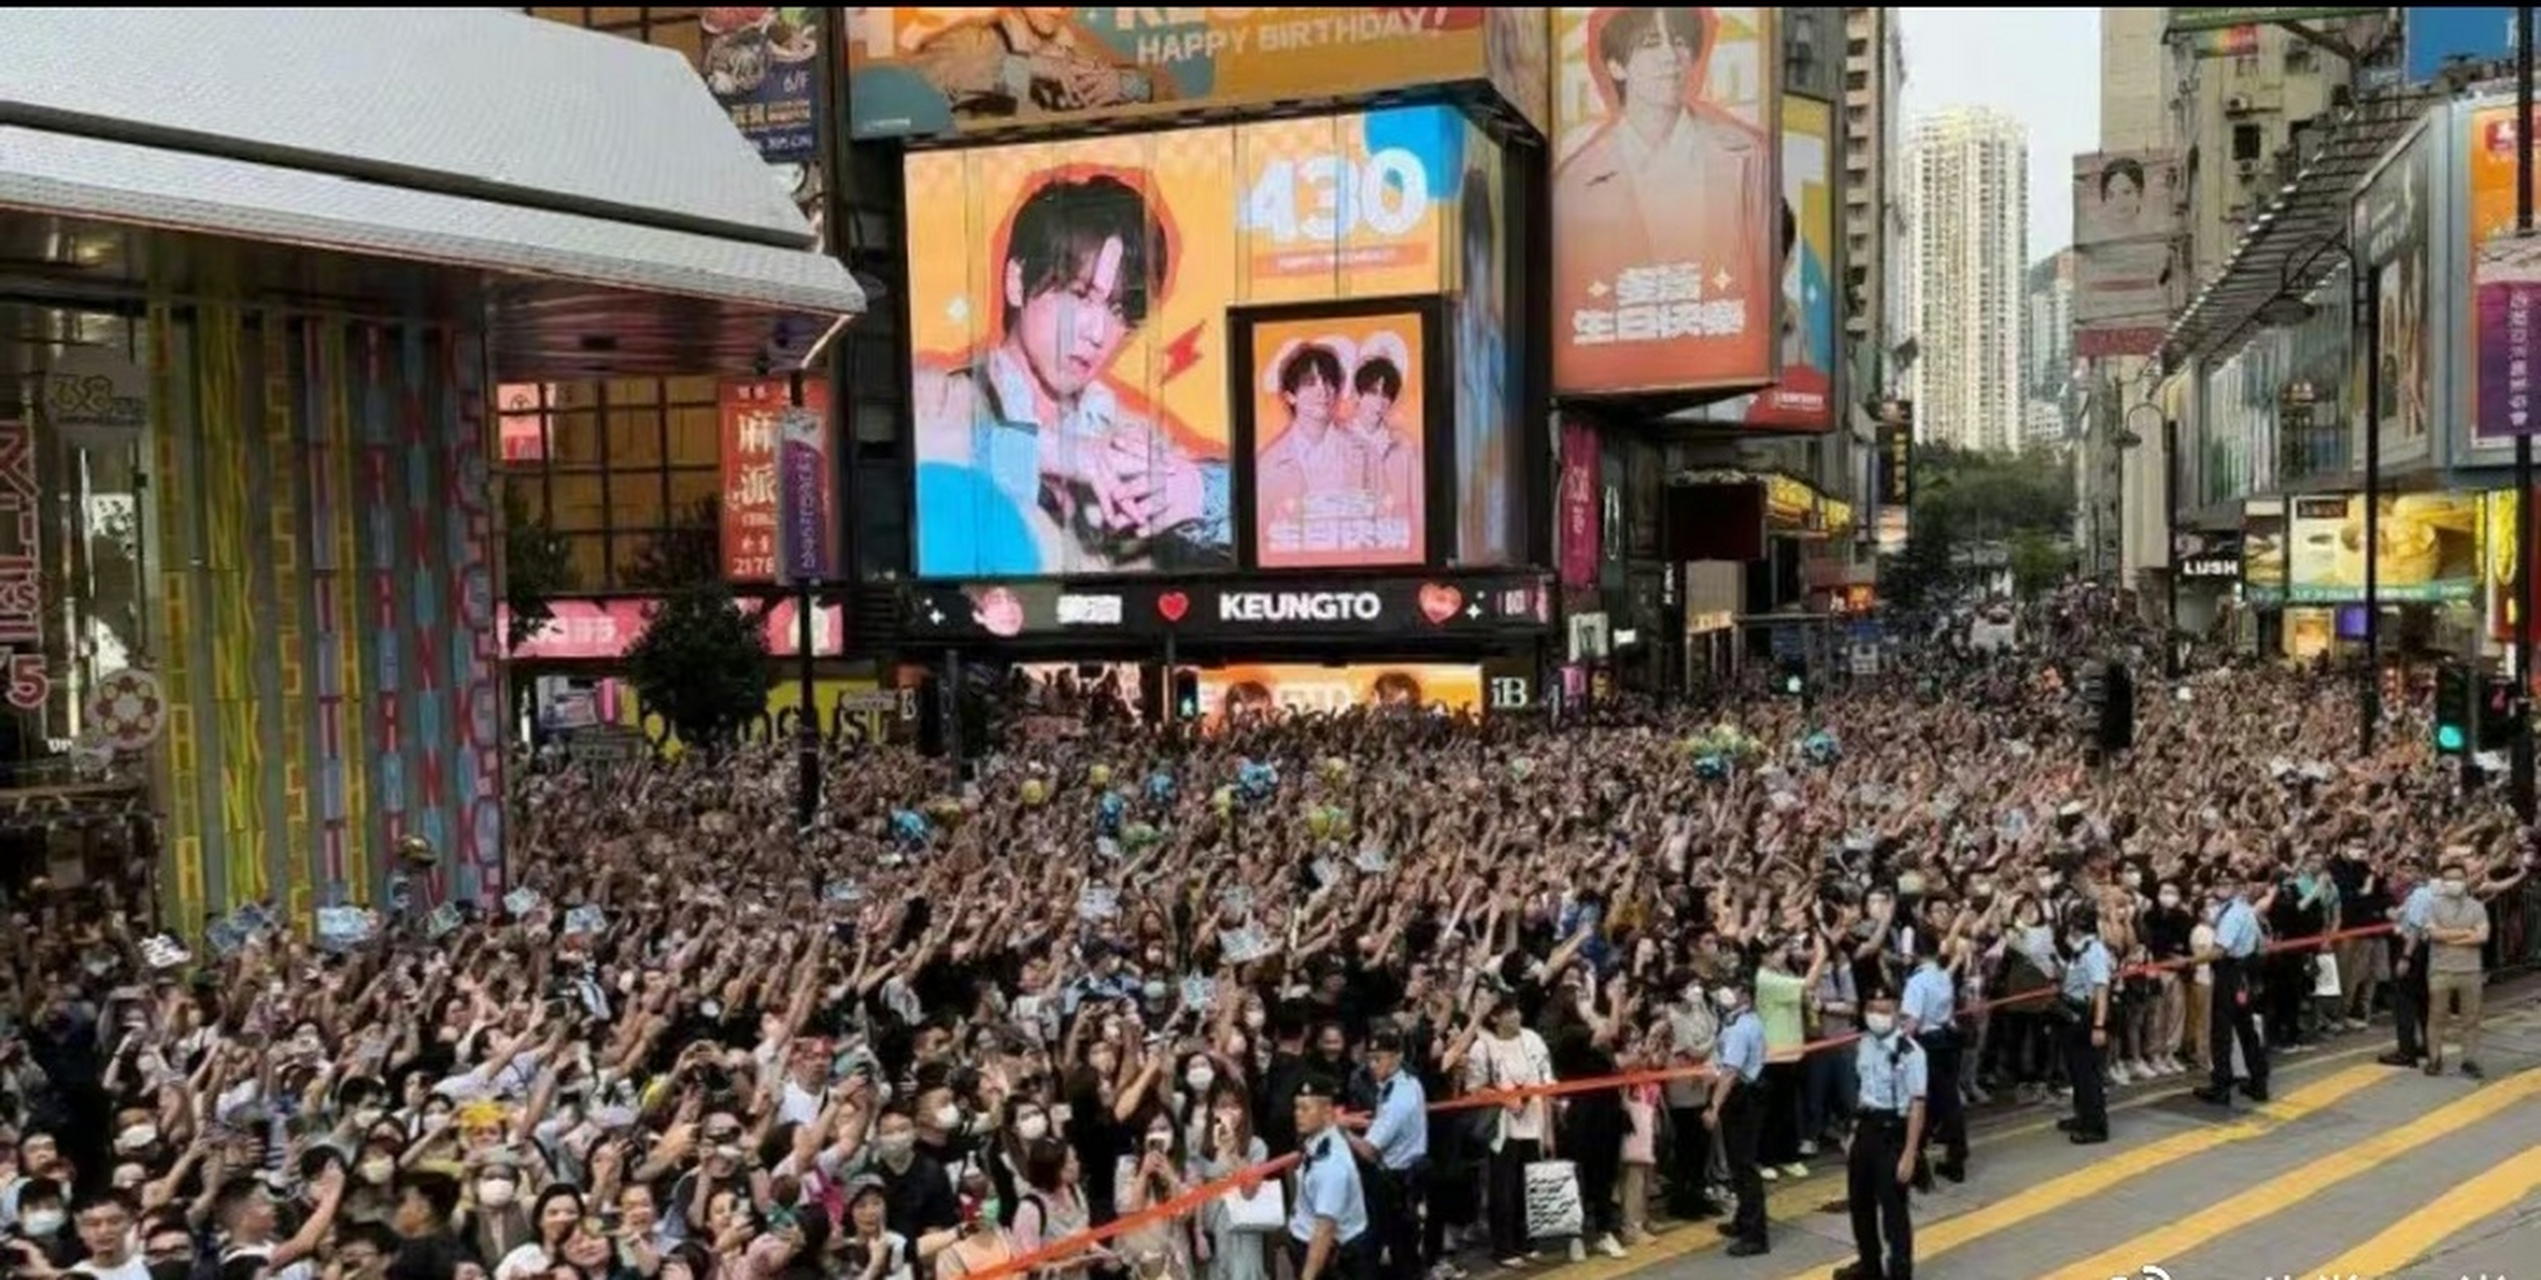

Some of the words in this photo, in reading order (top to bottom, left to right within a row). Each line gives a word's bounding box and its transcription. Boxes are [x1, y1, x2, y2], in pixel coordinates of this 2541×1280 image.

[1137, 32, 1250, 64] HAPPY
[1237, 147, 1428, 243] 430
[2183, 558, 2238, 576] LUSH
[1491, 676, 1528, 708] iB
